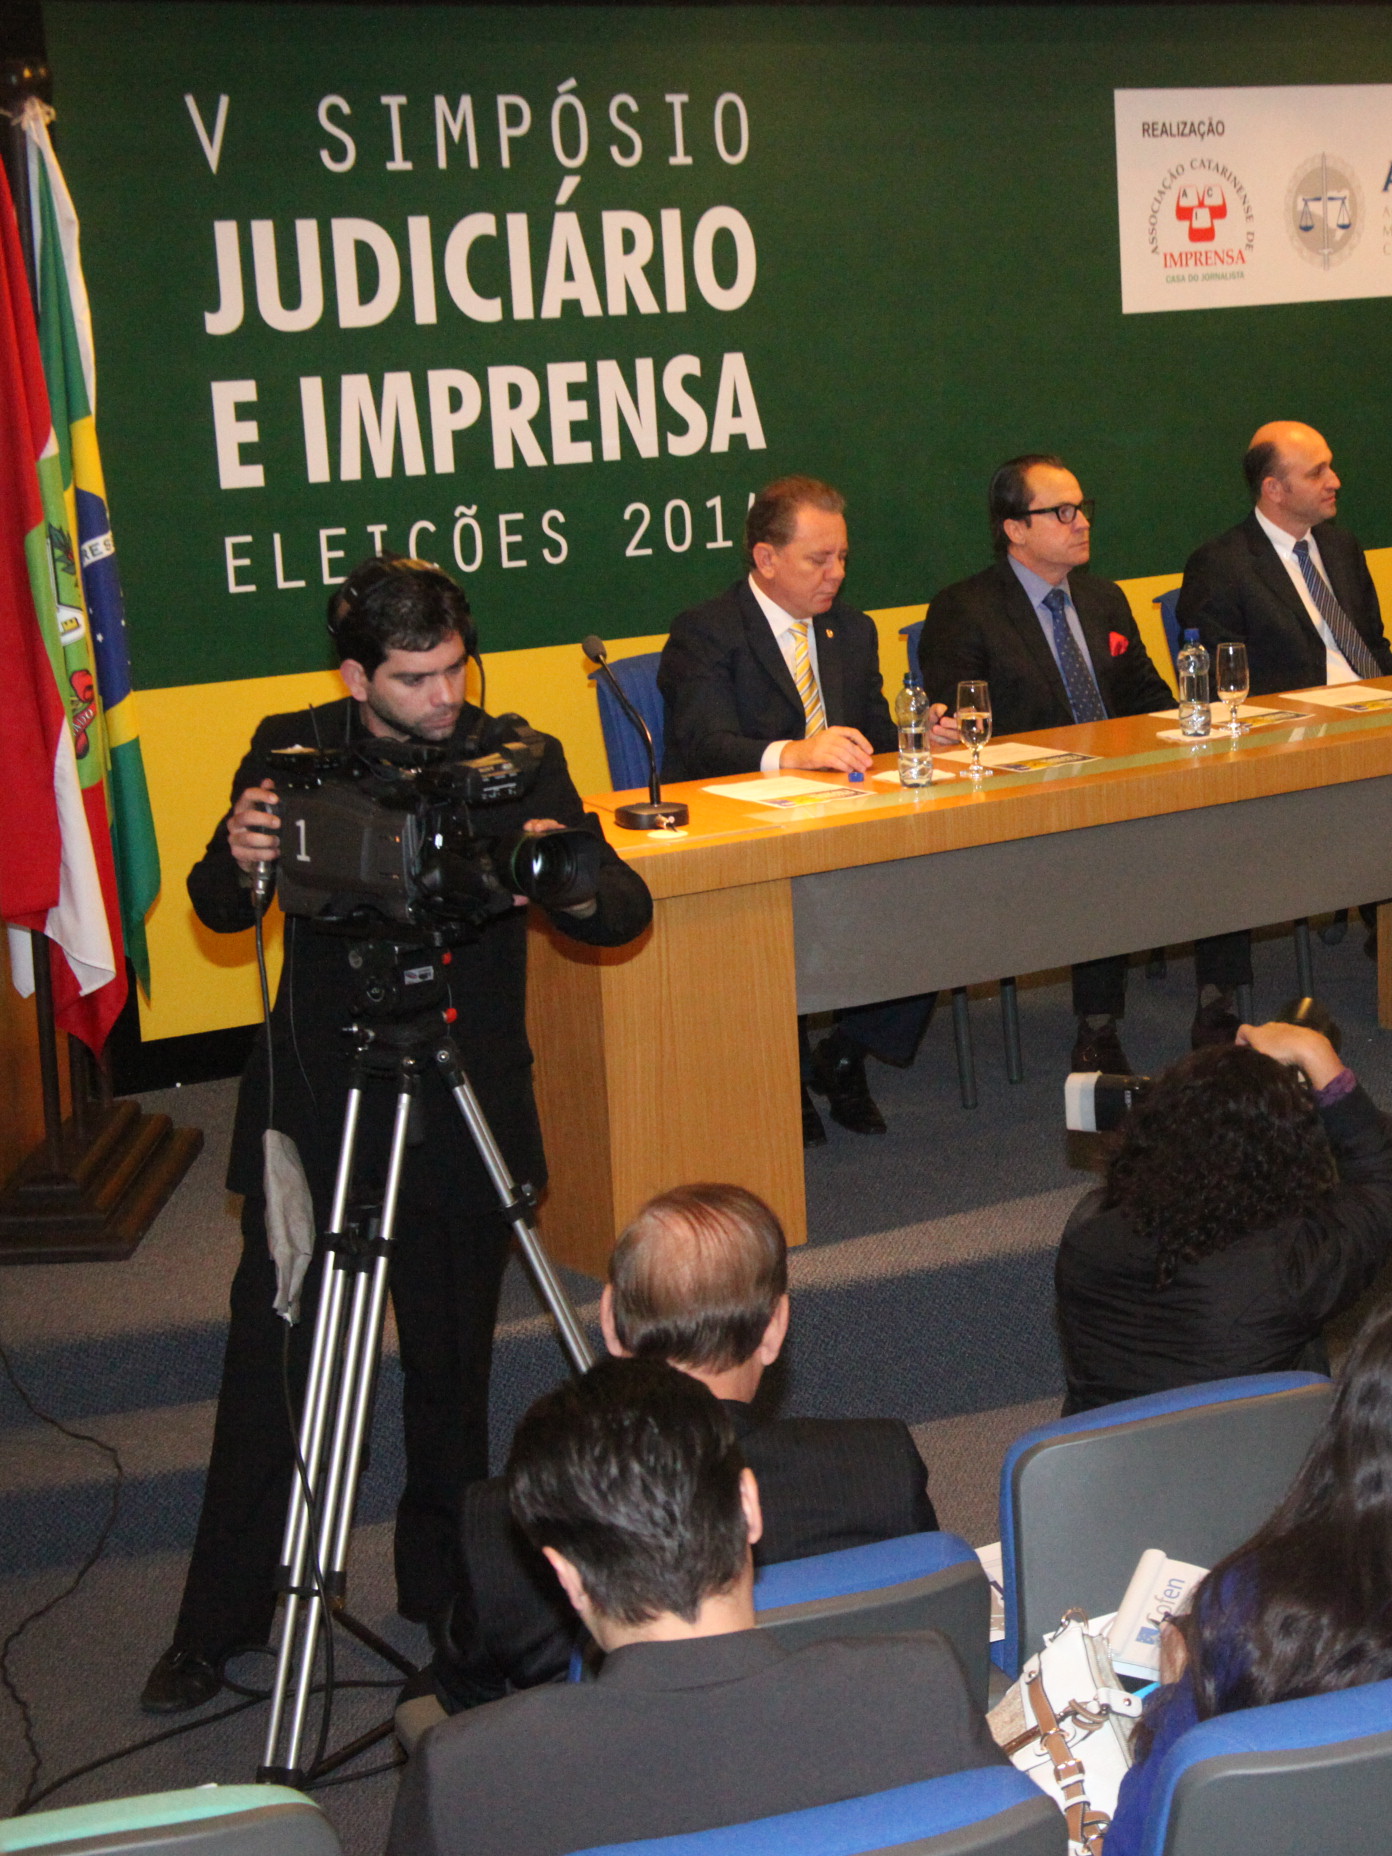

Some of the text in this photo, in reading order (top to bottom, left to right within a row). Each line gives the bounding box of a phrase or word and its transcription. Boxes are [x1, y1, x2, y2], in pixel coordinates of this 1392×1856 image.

[184, 77, 750, 175] V SIMPÓSIO
[1142, 117, 1225, 141] REALIZAÇÃO
[1148, 158, 1255, 255] ASSOCIAÇÃO CATARINENSE DE
[203, 175, 758, 335] JUDICIÁRIO
[1163, 248, 1246, 268] IMPRENSA
[1166, 270, 1245, 284] CASA DO JORNALISTA
[210, 351, 767, 490] E IMPRENSA
[623, 492, 755, 557] 201
[296, 819, 310, 862] 1
